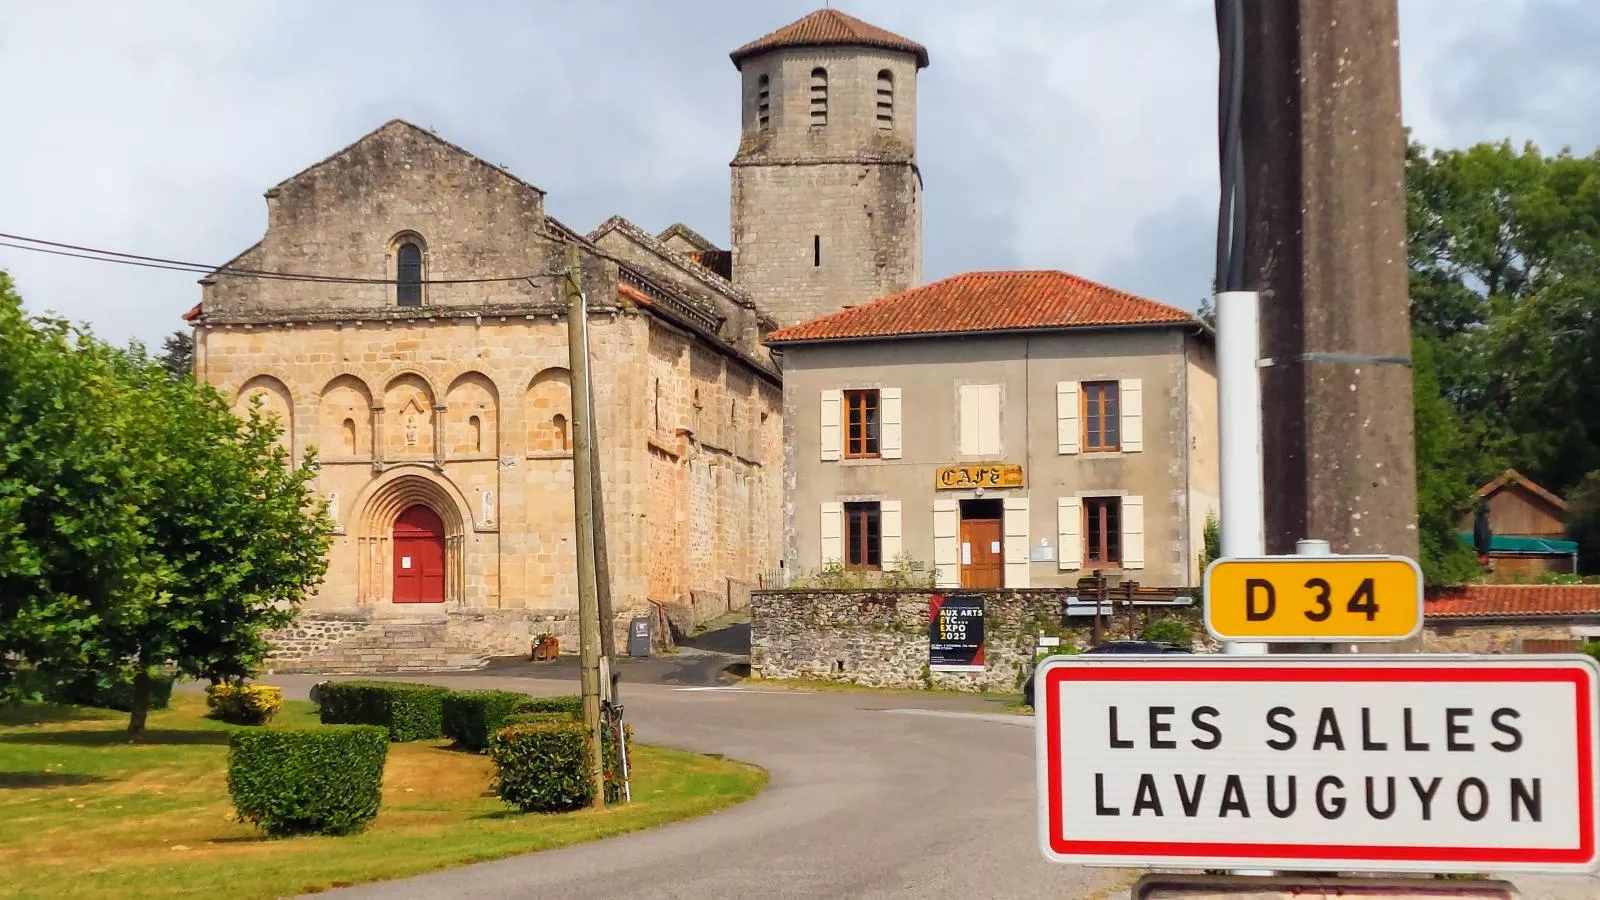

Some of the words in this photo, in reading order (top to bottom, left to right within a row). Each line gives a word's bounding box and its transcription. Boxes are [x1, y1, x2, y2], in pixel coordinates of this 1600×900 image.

[1245, 578, 1276, 622] D
[1304, 577, 1379, 622] 34
[940, 609, 958, 617] AUX
[960, 609, 983, 617] ARTS
[940, 624, 966, 632] EXPO
[940, 632, 966, 640] 2023
[1108, 705, 1222, 751] LES
[1266, 706, 1523, 753] SALLES
[1094, 772, 1543, 823] LAVAUGUYON
